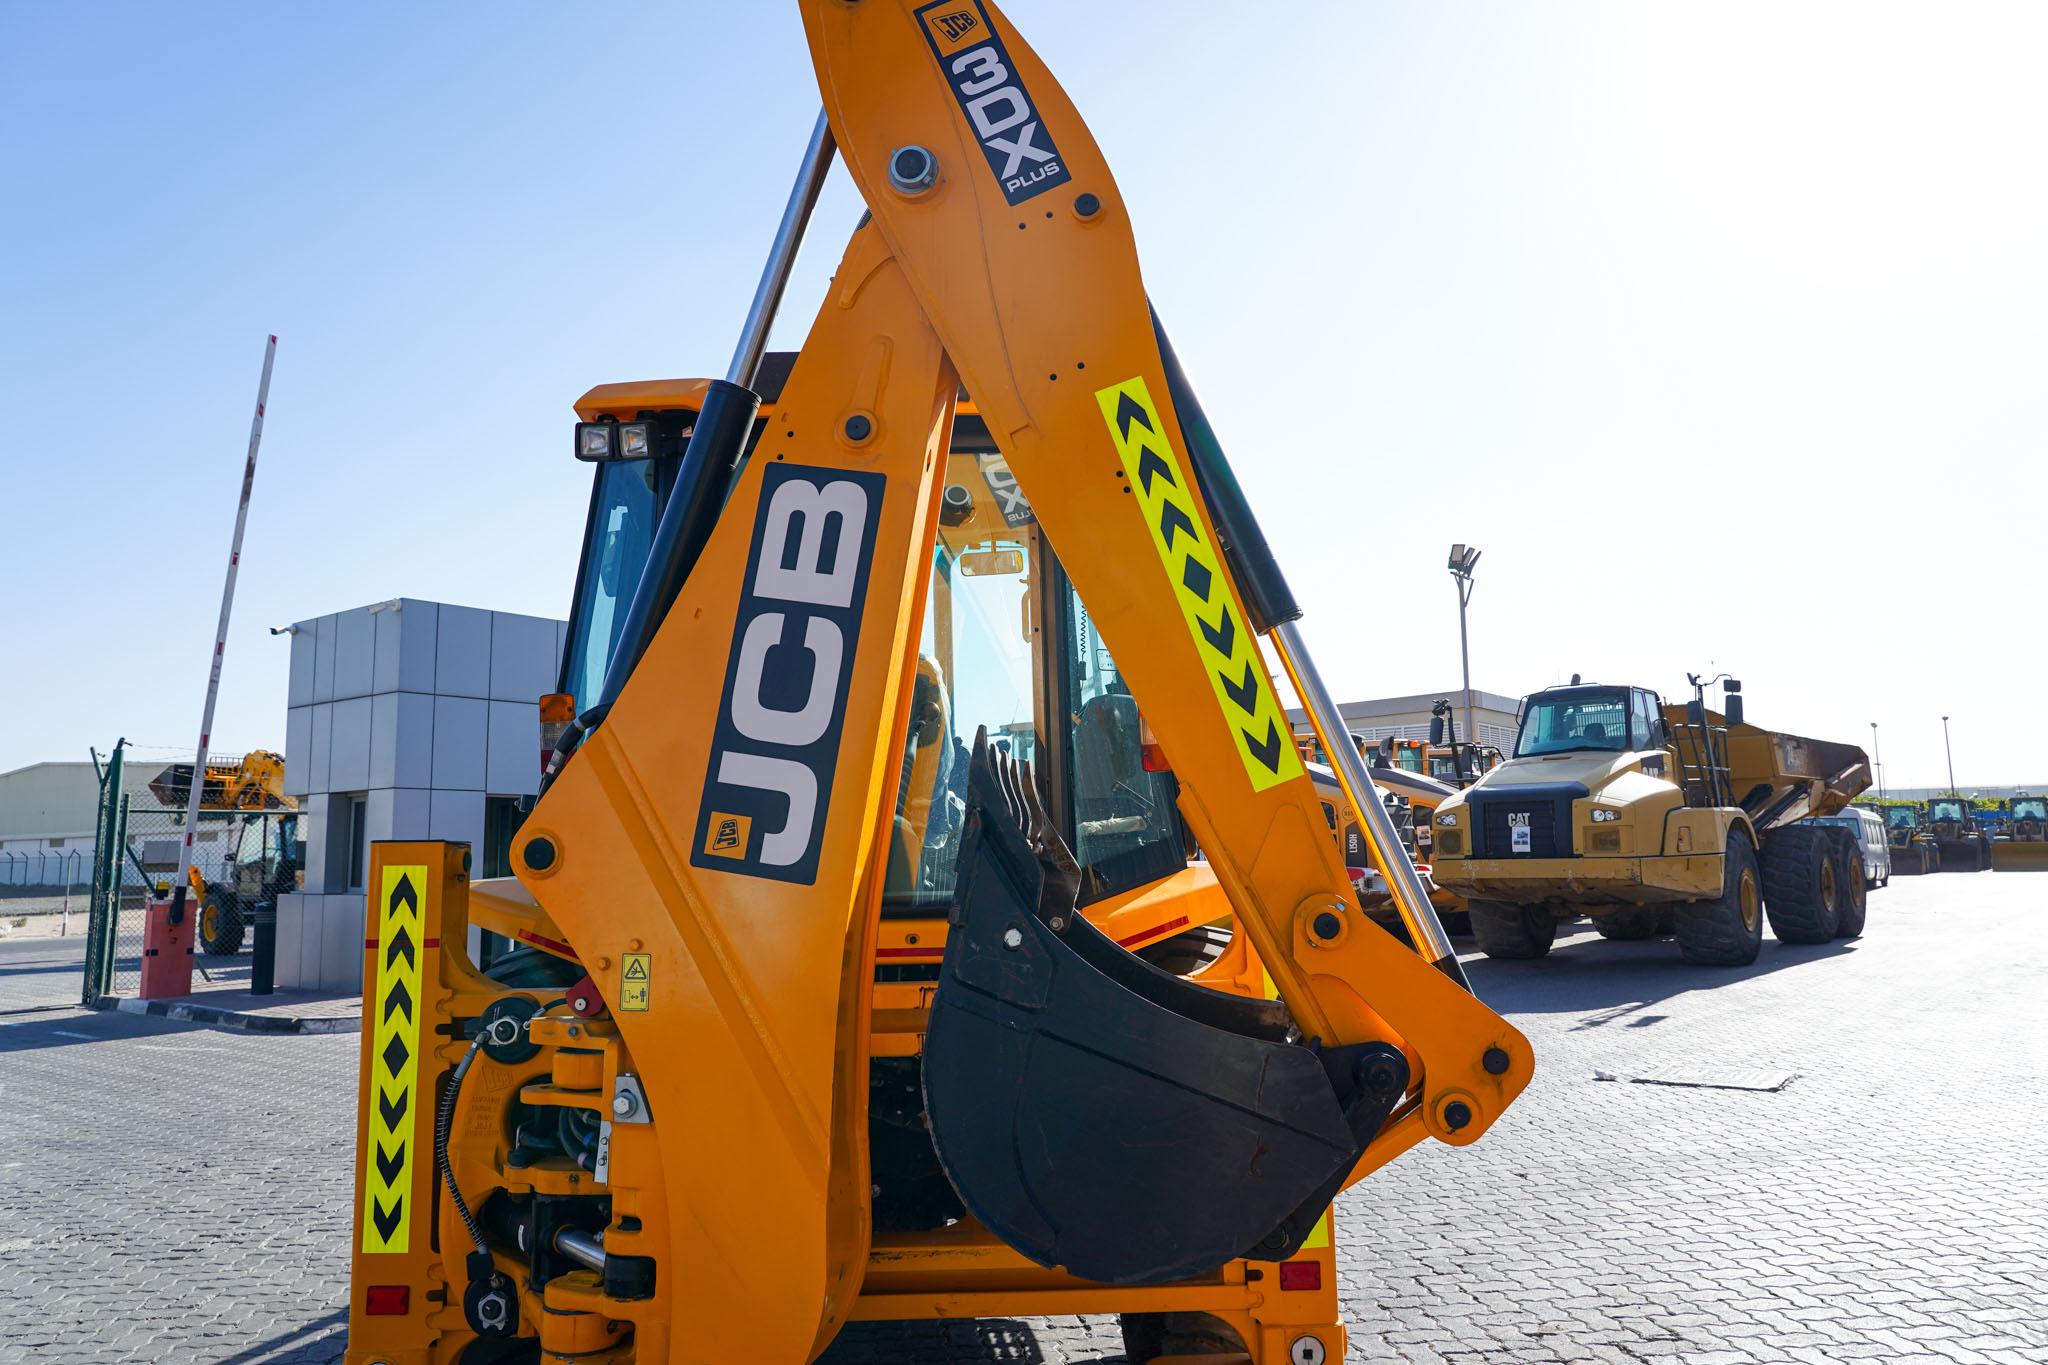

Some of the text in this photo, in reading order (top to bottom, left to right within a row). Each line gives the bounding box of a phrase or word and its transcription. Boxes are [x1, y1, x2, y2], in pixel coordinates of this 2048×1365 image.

[939, 12, 975, 39] JCB
[951, 46, 1057, 181] 3DX
[1006, 161, 1061, 193] PLUS
[717, 479, 868, 867] JCB
[716, 821, 737, 846] JCB
[1508, 812, 1531, 828] CAT
